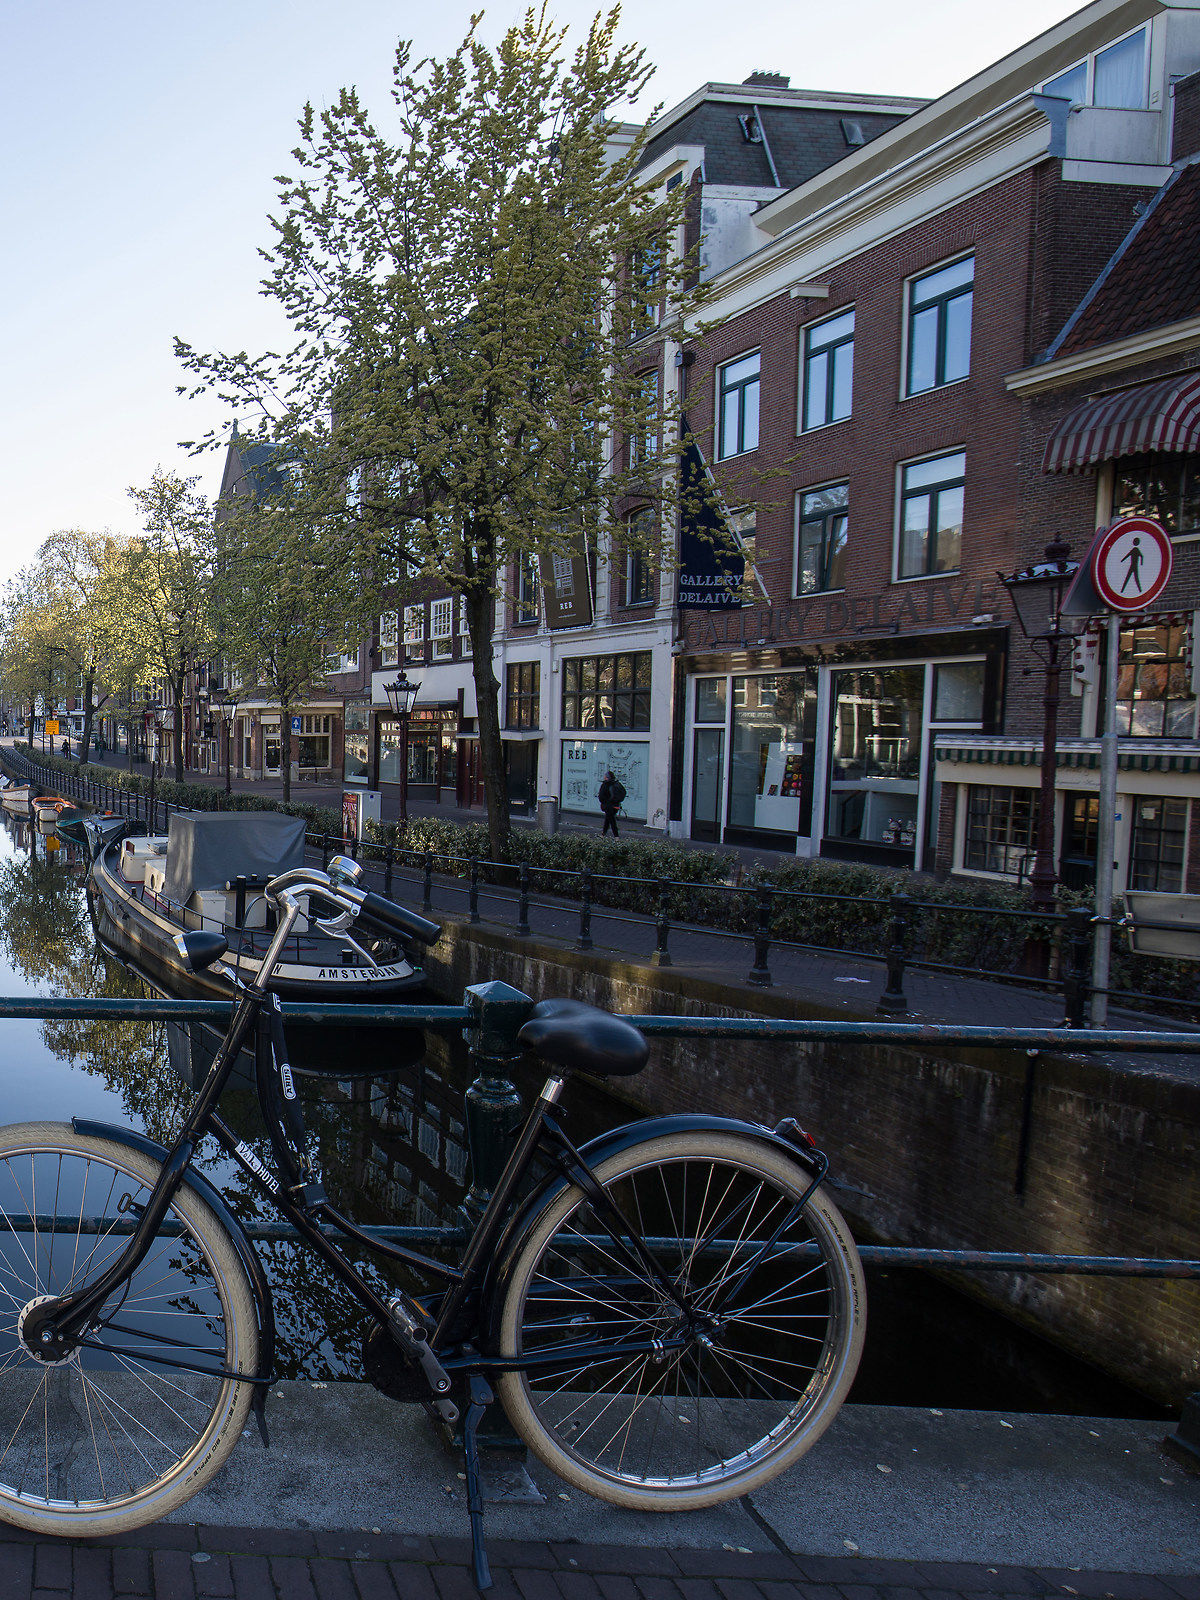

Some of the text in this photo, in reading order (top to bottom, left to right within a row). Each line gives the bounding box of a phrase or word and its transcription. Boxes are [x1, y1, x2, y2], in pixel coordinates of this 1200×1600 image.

[680, 574, 743, 586] GALLERY
[679, 592, 741, 604] DELAIVE
[559, 601, 574, 610] REB
[684, 578, 1001, 649] GALLERY DELAIVE
[568, 749, 587, 760] REB
[256, 1165, 280, 1195] HOTEL
